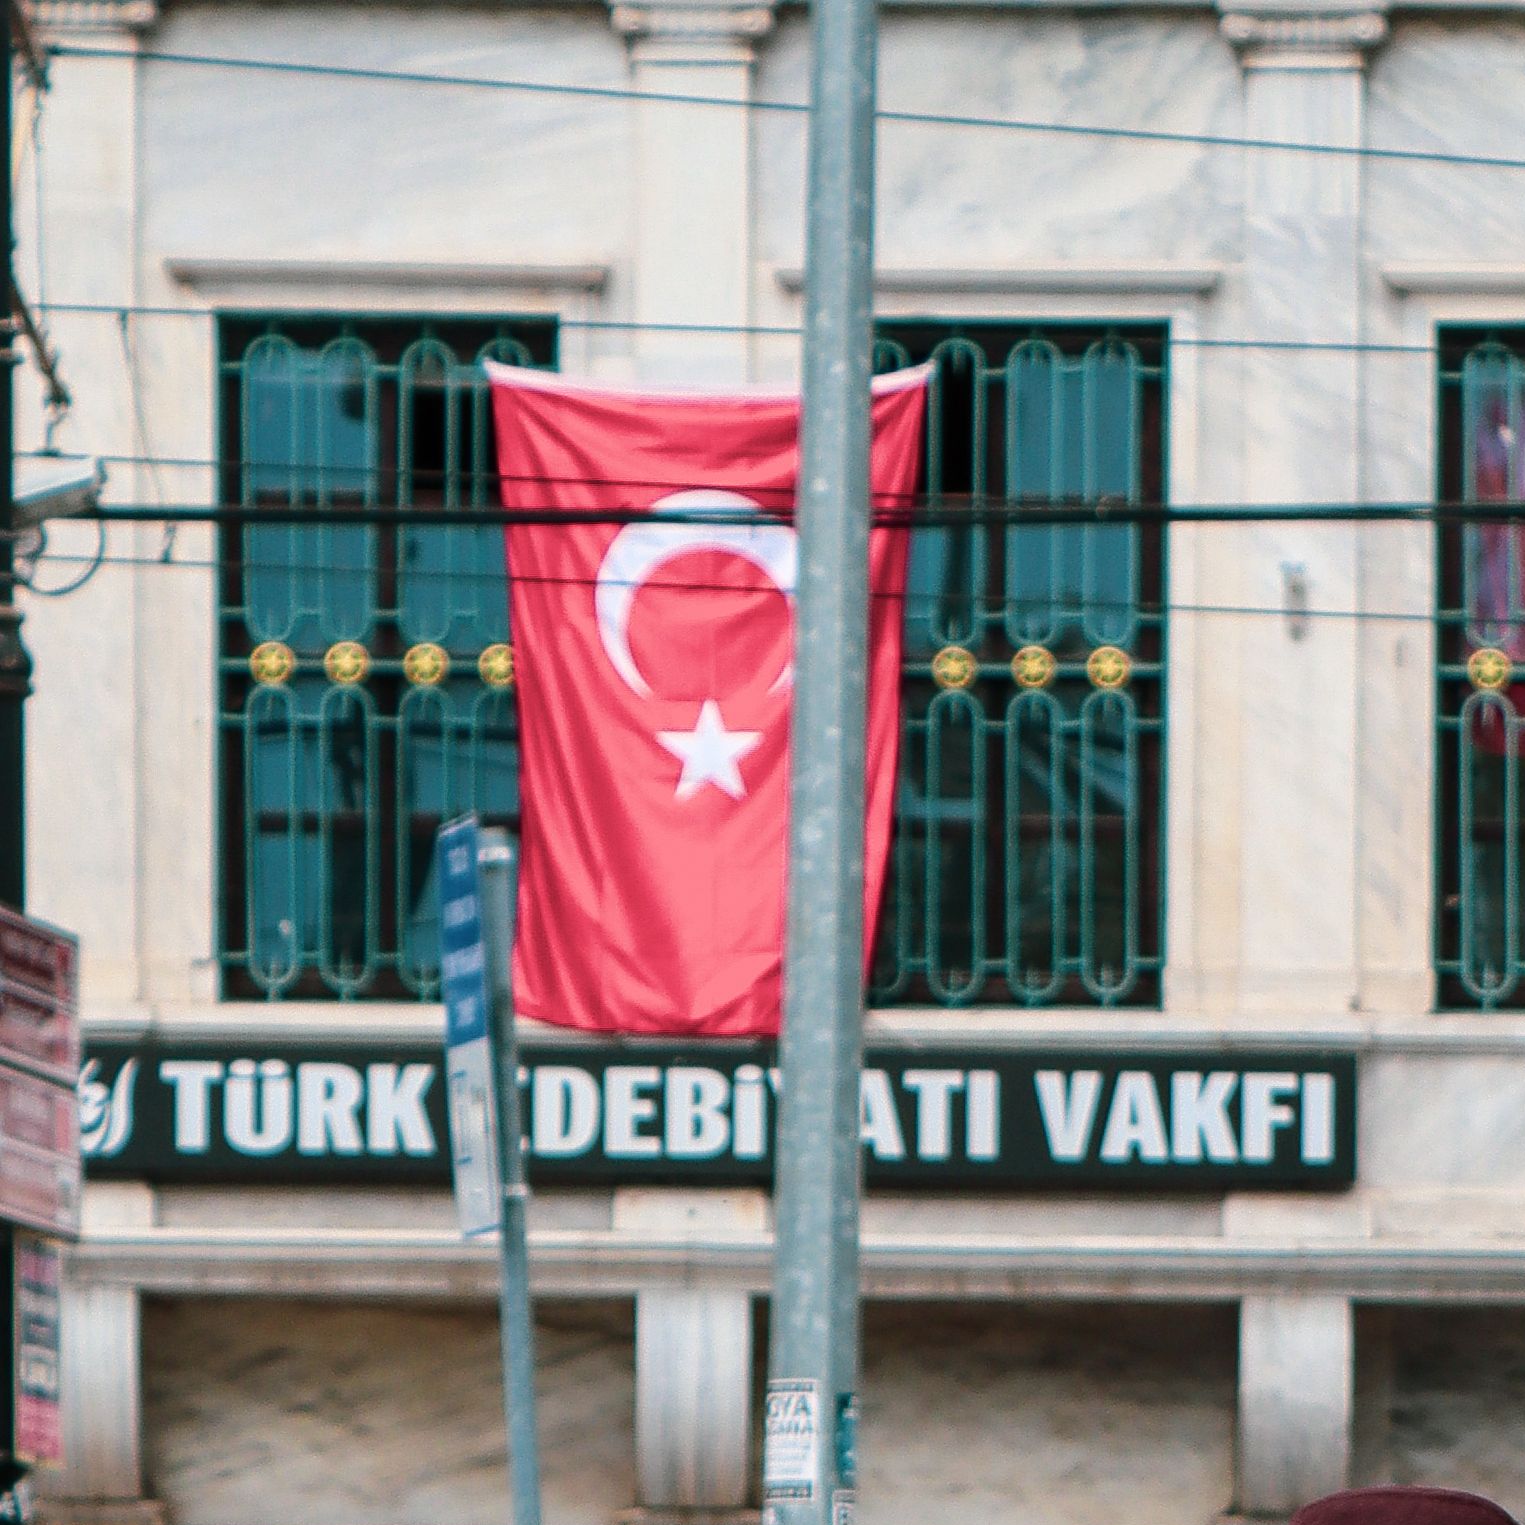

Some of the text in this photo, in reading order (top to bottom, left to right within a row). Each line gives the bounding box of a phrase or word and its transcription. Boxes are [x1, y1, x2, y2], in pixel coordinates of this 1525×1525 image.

[160, 1058, 437, 1156] TÜRK
[515, 1064, 1000, 1161] DEBİATI
[1034, 1069, 1335, 1163] VAKFI
